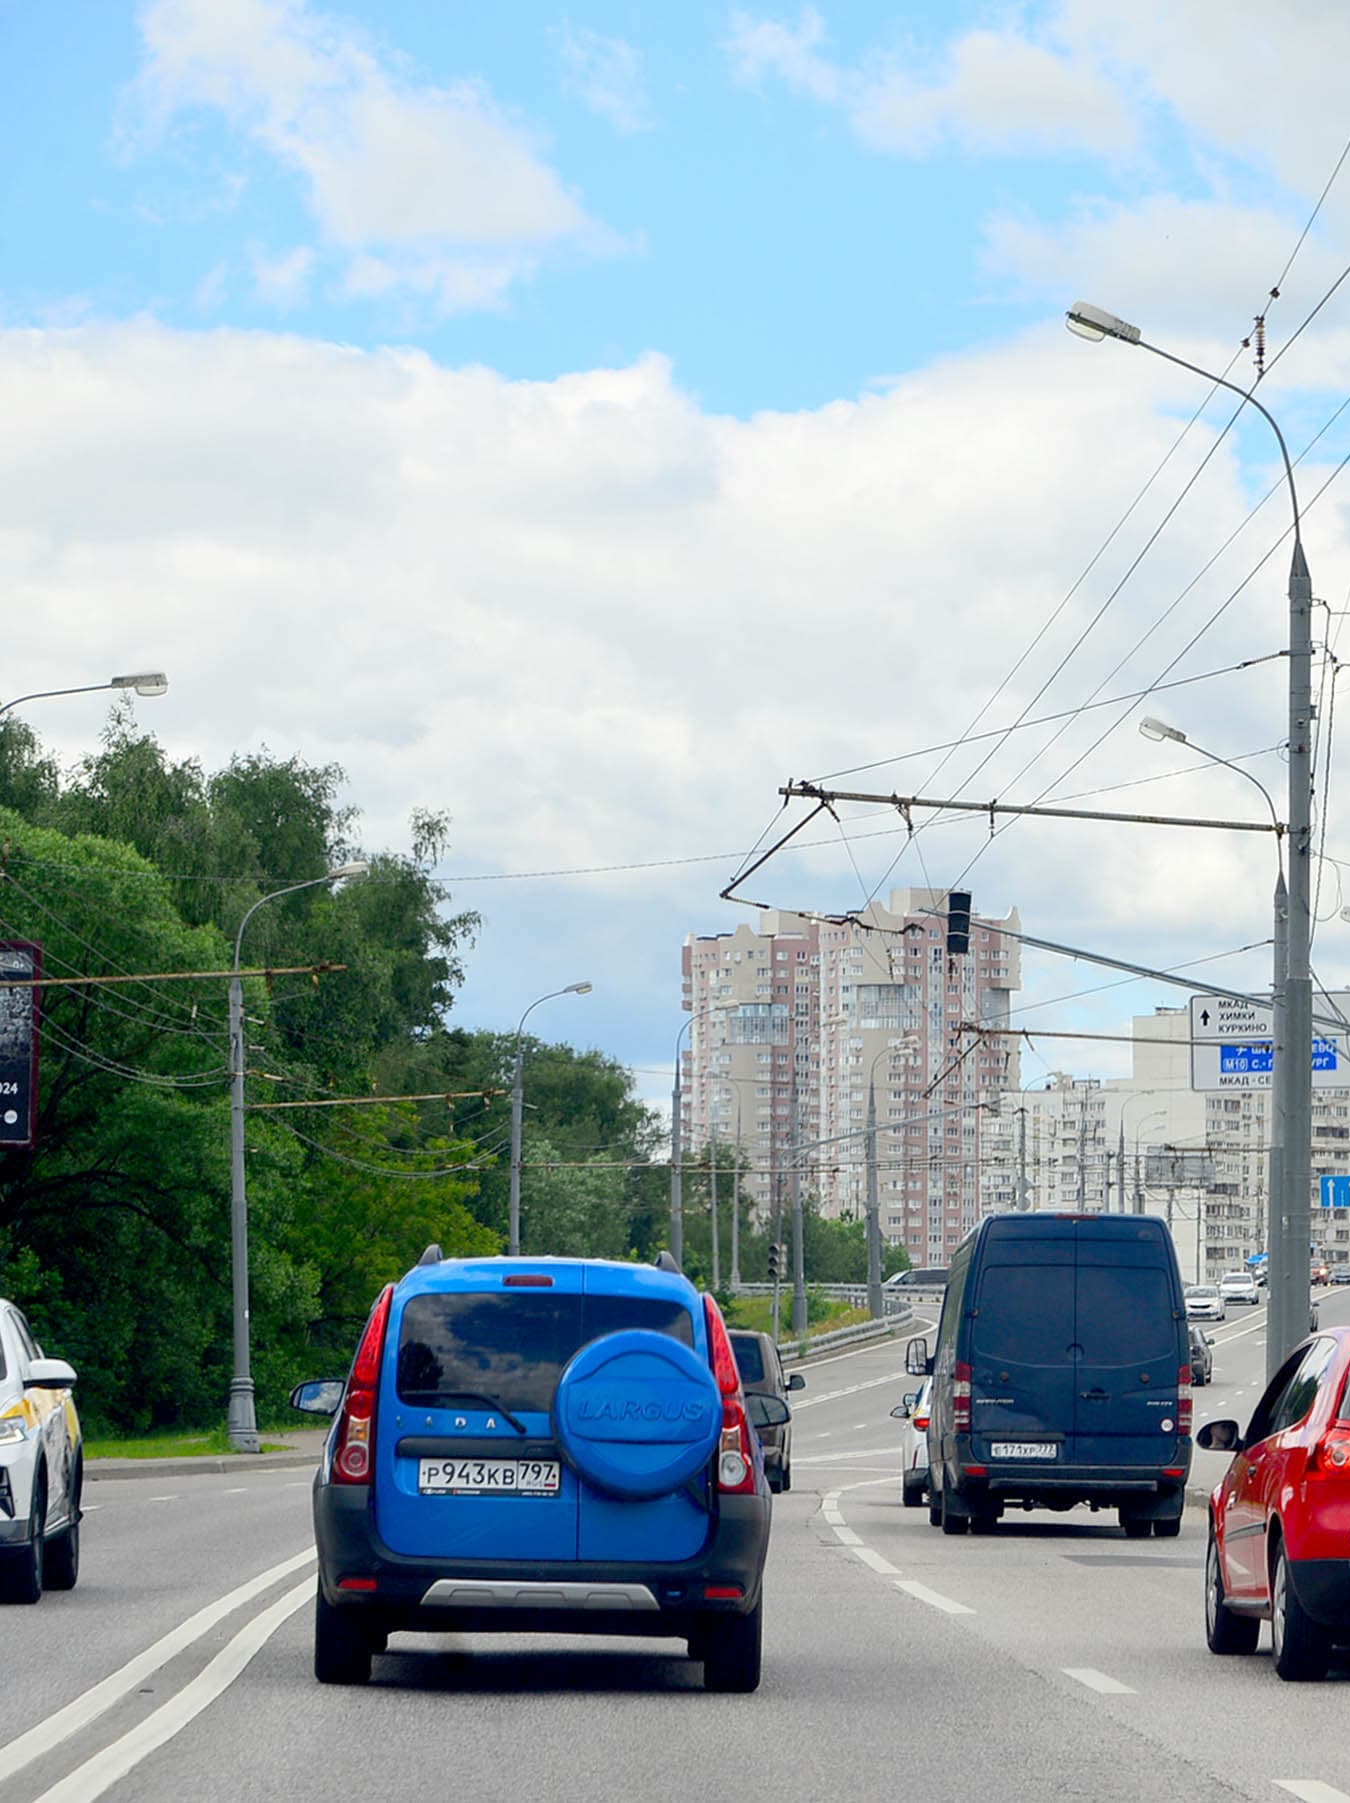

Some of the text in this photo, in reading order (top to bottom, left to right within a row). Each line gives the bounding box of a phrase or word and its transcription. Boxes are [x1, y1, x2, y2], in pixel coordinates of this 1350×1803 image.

[1218, 1022, 1267, 1033] КУРКИНО
[1219, 1076, 1249, 1086] МКАД
[577, 1401, 704, 1422] LARGUS
